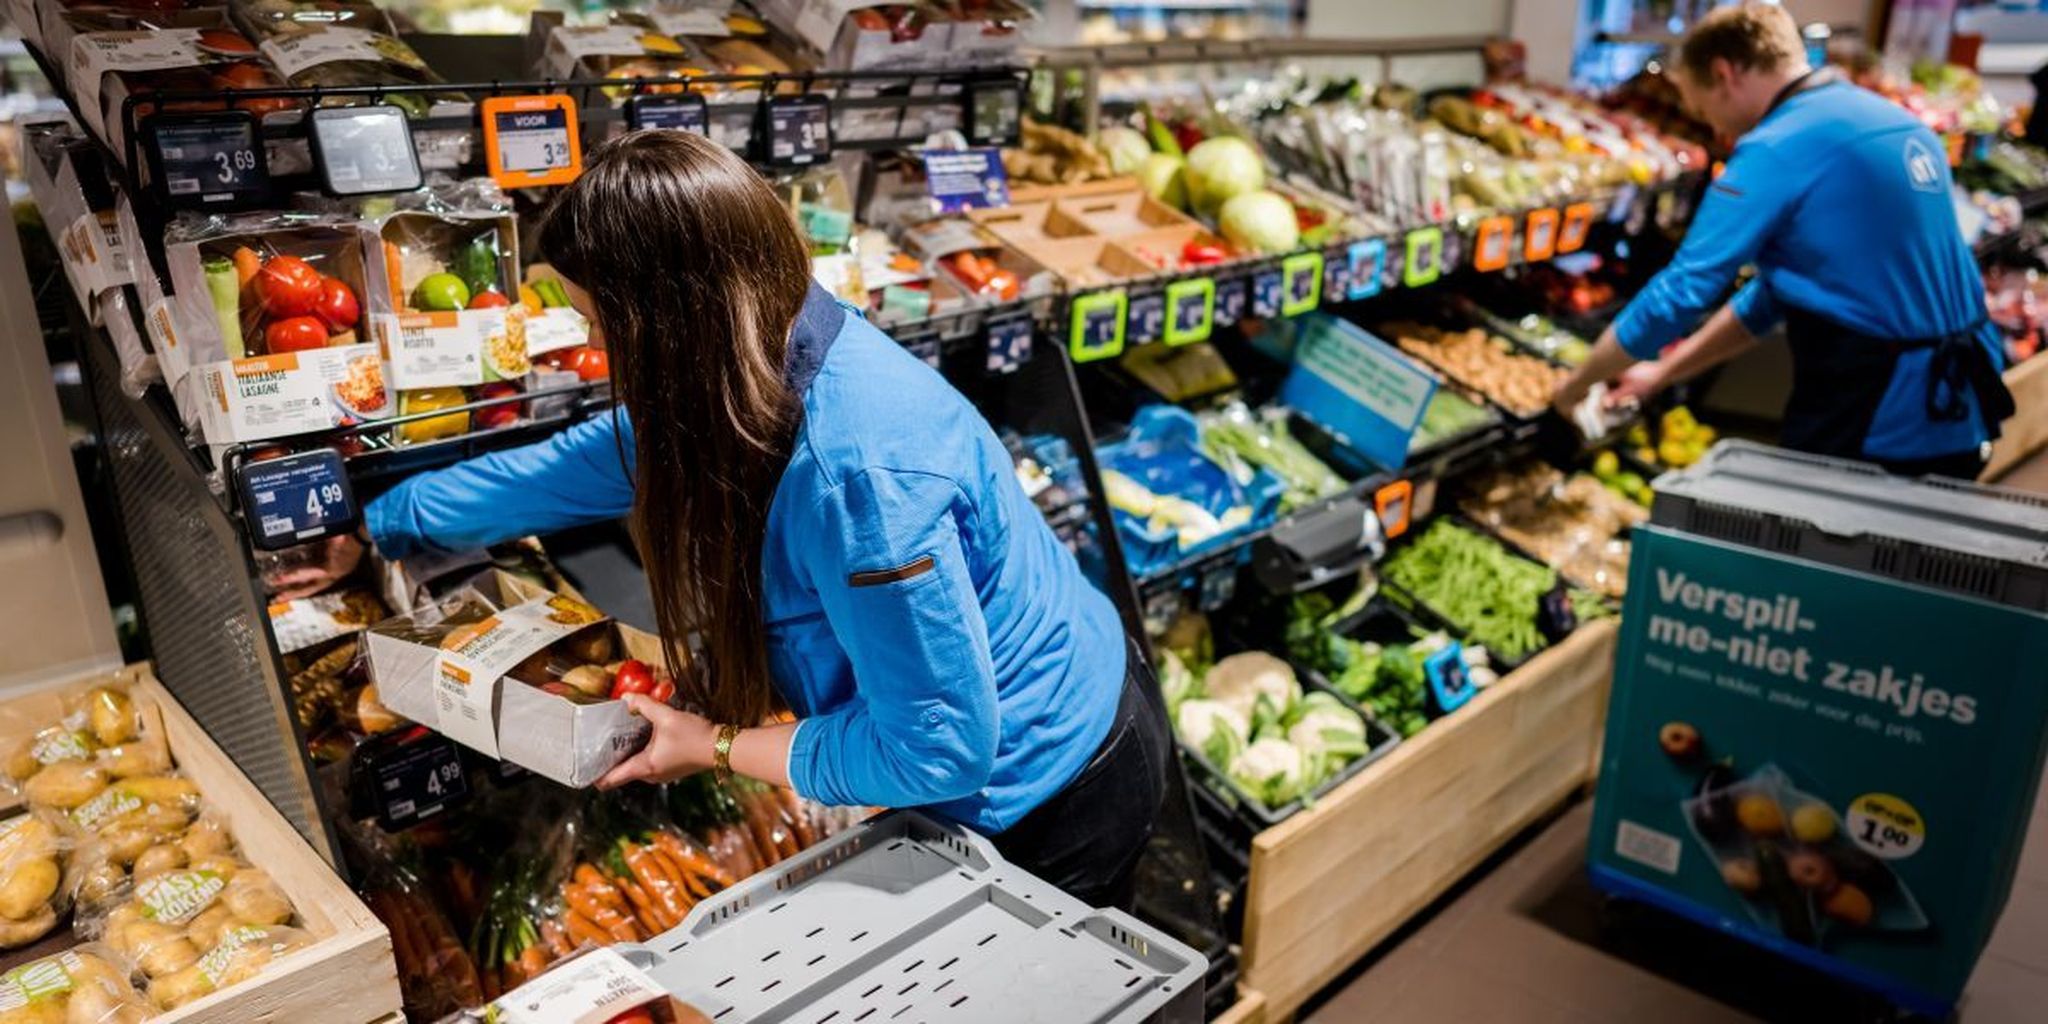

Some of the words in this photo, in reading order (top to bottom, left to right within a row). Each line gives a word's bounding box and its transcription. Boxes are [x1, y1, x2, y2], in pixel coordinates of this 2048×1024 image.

[513, 115, 548, 127] VOOR
[214, 149, 256, 183] 3.69
[238, 370, 287, 386] ITALIAANSE
[240, 382, 280, 398] LASAGNE
[306, 483, 343, 518] 4.99
[1656, 567, 1815, 634] Verspil-
[1648, 613, 1812, 682] me-niet
[1822, 658, 1978, 724] zakjes
[427, 762, 460, 796] 4.99
[1859, 818, 1909, 850] 1.00
[145, 871, 204, 912] VAST
[157, 876, 225, 920] KOKEND
